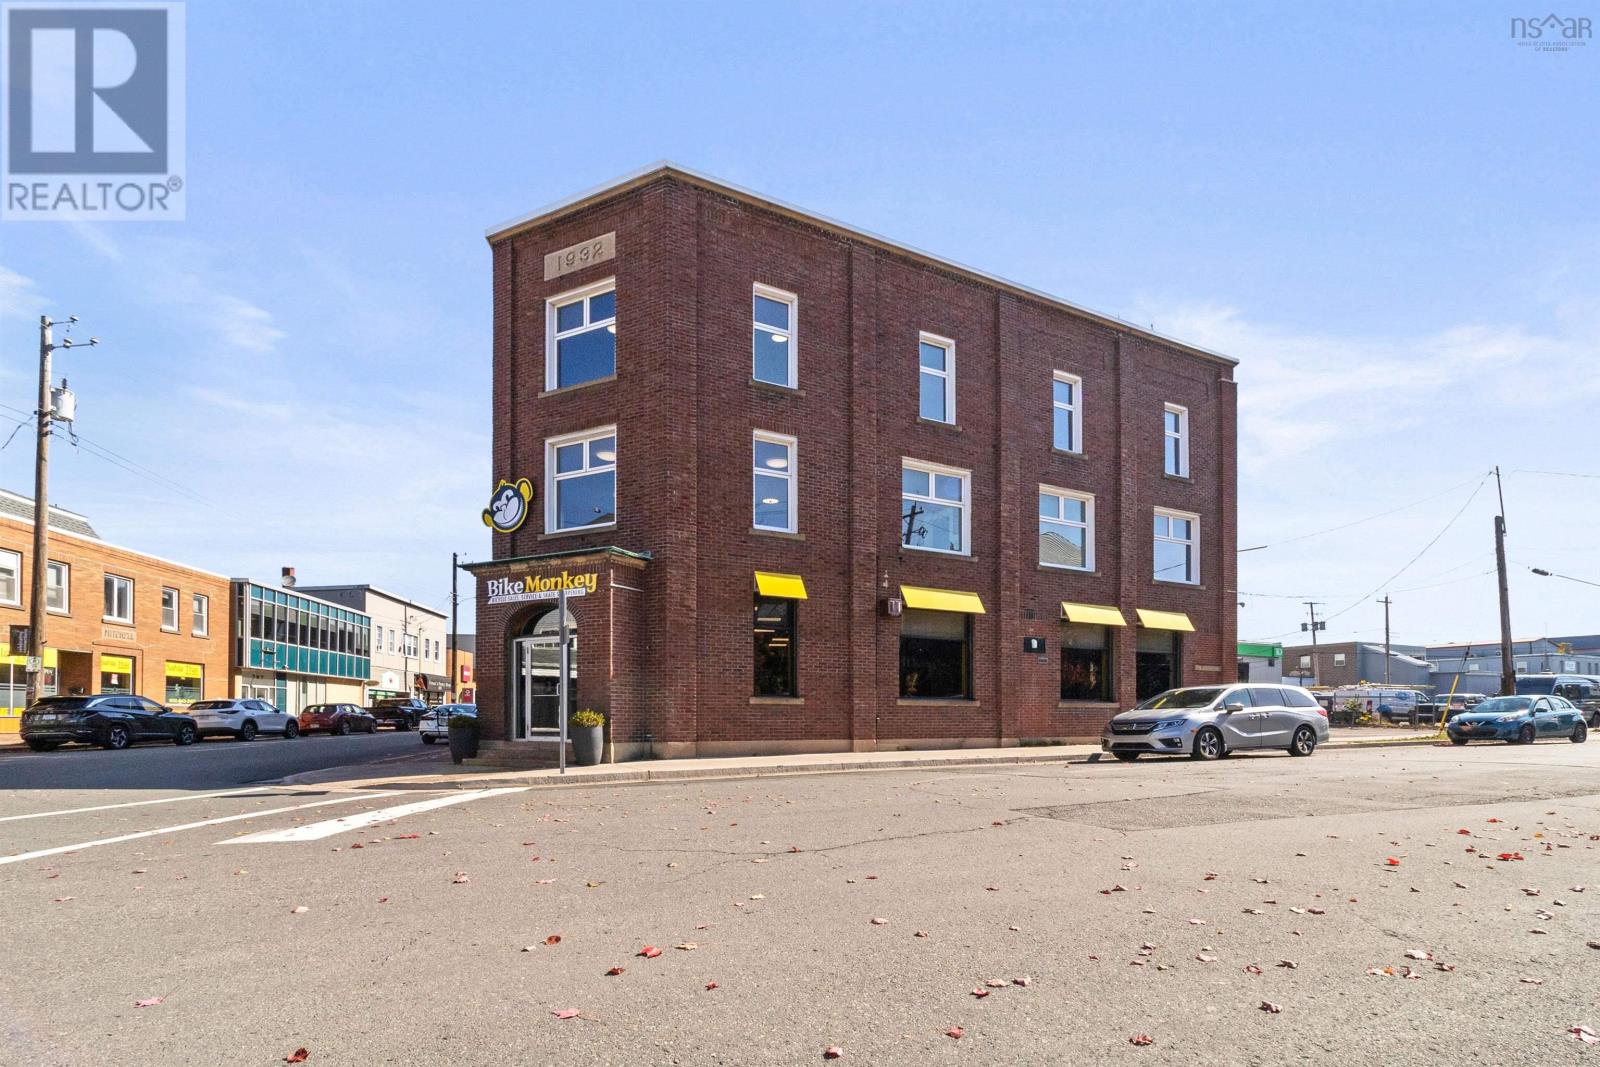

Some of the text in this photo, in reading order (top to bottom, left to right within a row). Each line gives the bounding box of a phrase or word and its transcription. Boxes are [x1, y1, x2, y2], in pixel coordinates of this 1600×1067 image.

[557, 242, 604, 271] 1932
[487, 570, 598, 597] Bike Monkey
